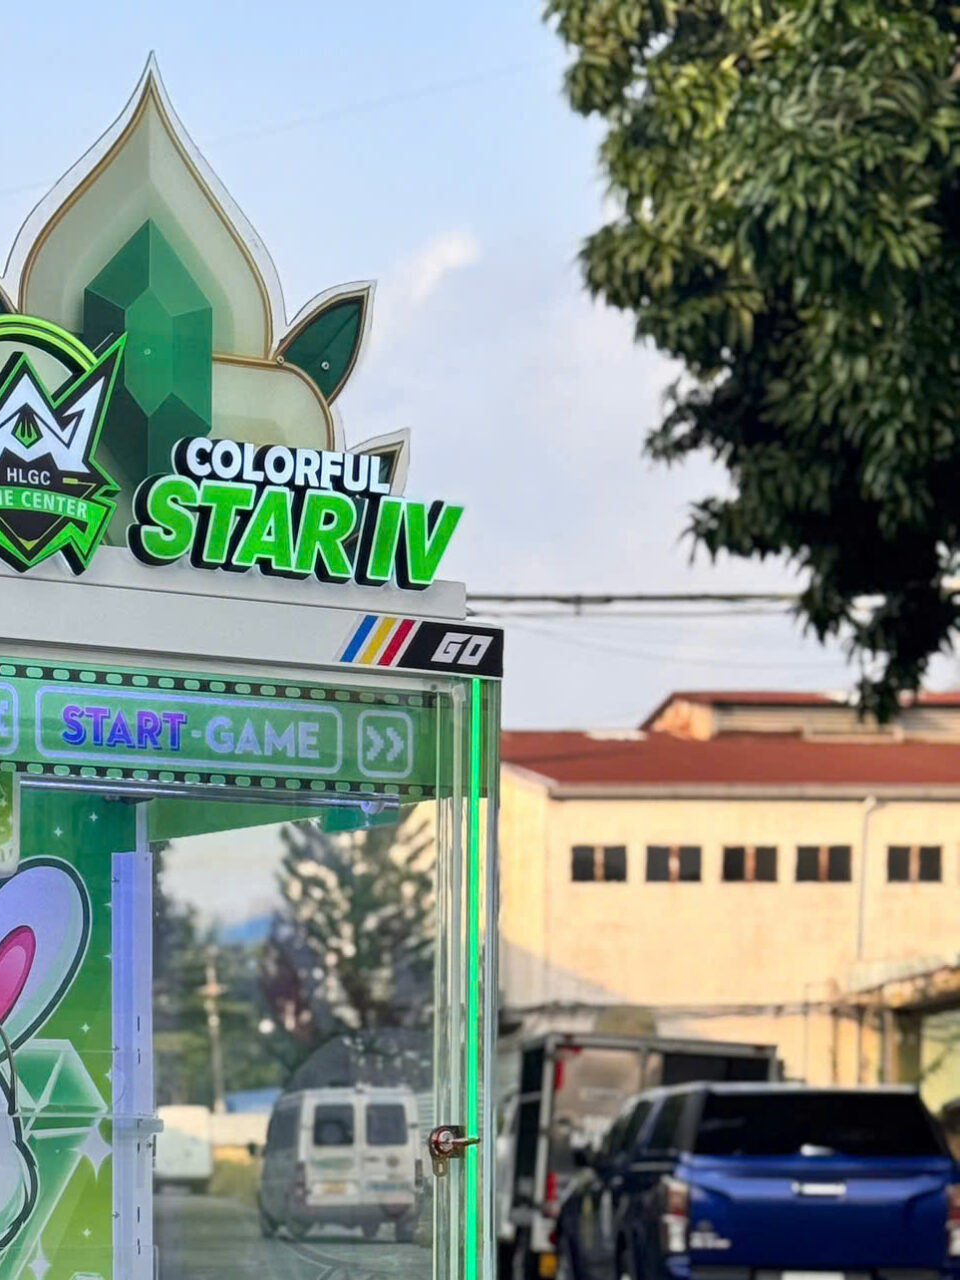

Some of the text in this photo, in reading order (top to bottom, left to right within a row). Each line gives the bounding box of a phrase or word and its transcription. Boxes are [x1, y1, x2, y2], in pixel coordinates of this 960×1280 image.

[7, 467, 51, 486] HLGC
[186, 437, 390, 494] COLORFUL
[21, 493, 88, 519] CENTER
[140, 474, 464, 585] STAR IV
[430, 631, 494, 667] GO
